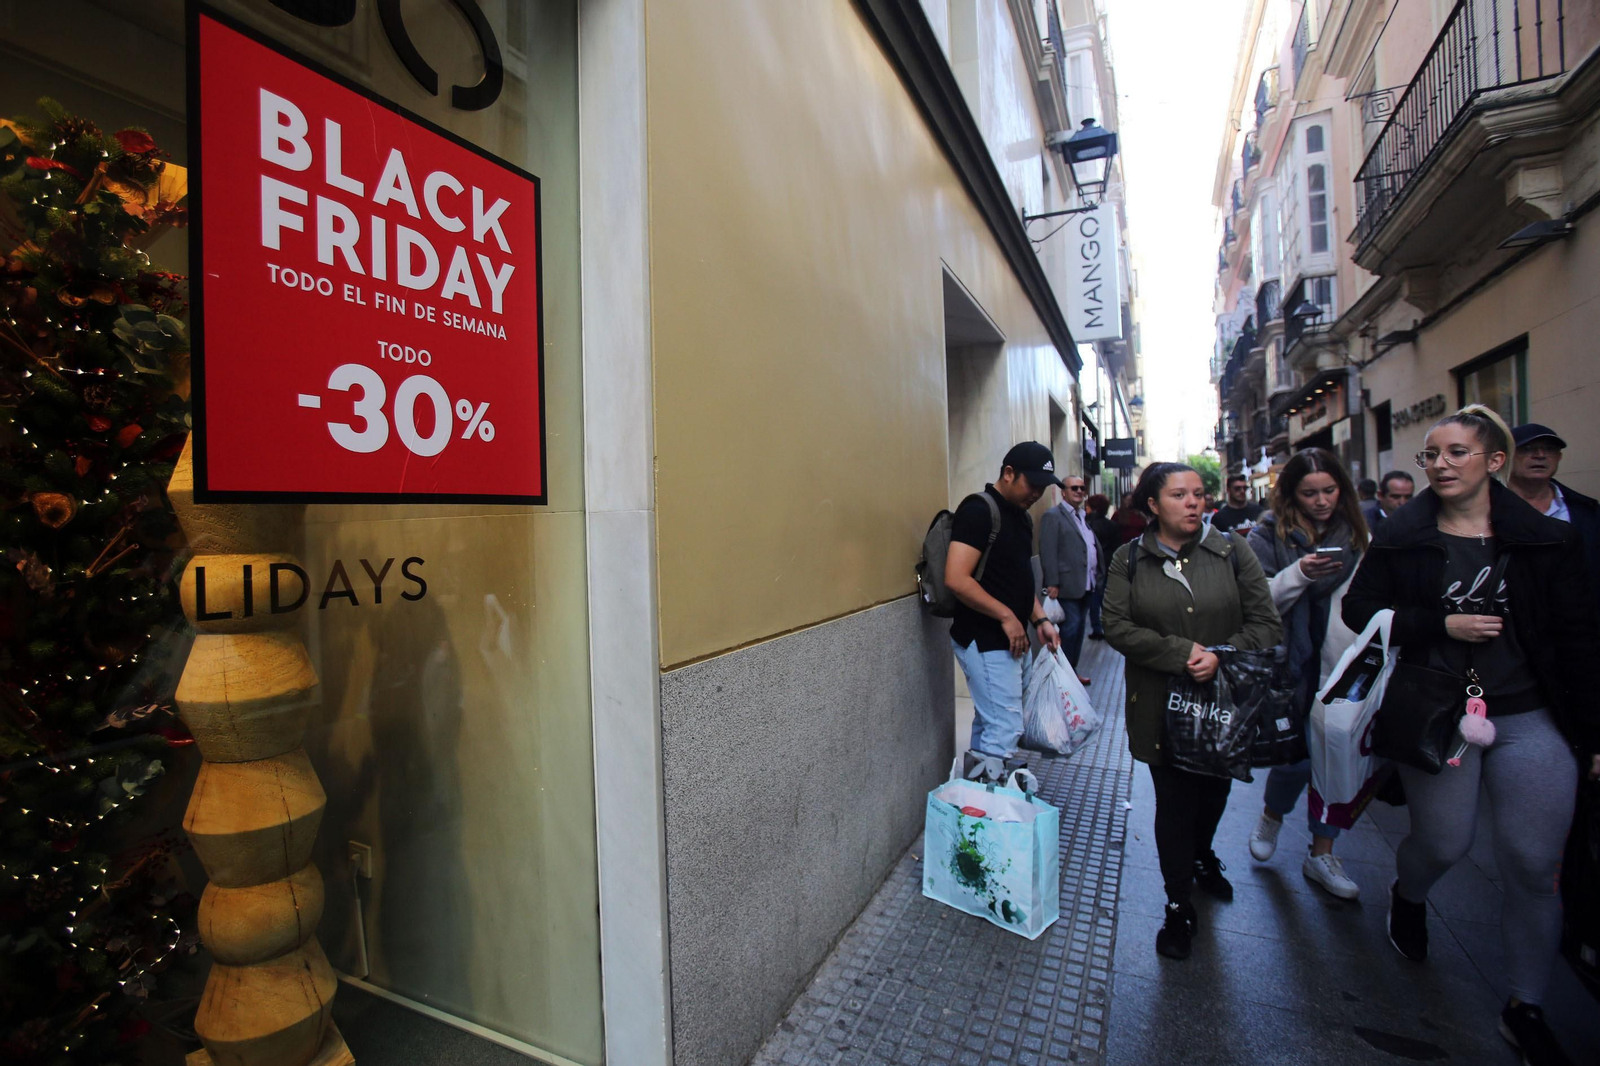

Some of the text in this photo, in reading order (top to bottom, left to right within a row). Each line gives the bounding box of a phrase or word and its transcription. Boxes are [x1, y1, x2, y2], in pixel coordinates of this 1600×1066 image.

[260, 87, 512, 254] BLACK
[261, 174, 515, 315] FRIDAY
[1080, 216, 1104, 328] MANGO
[267, 263, 507, 341] TODO EL FIN DE SEMANA
[377, 340, 432, 367] TODO
[298, 363, 496, 457] -30%
